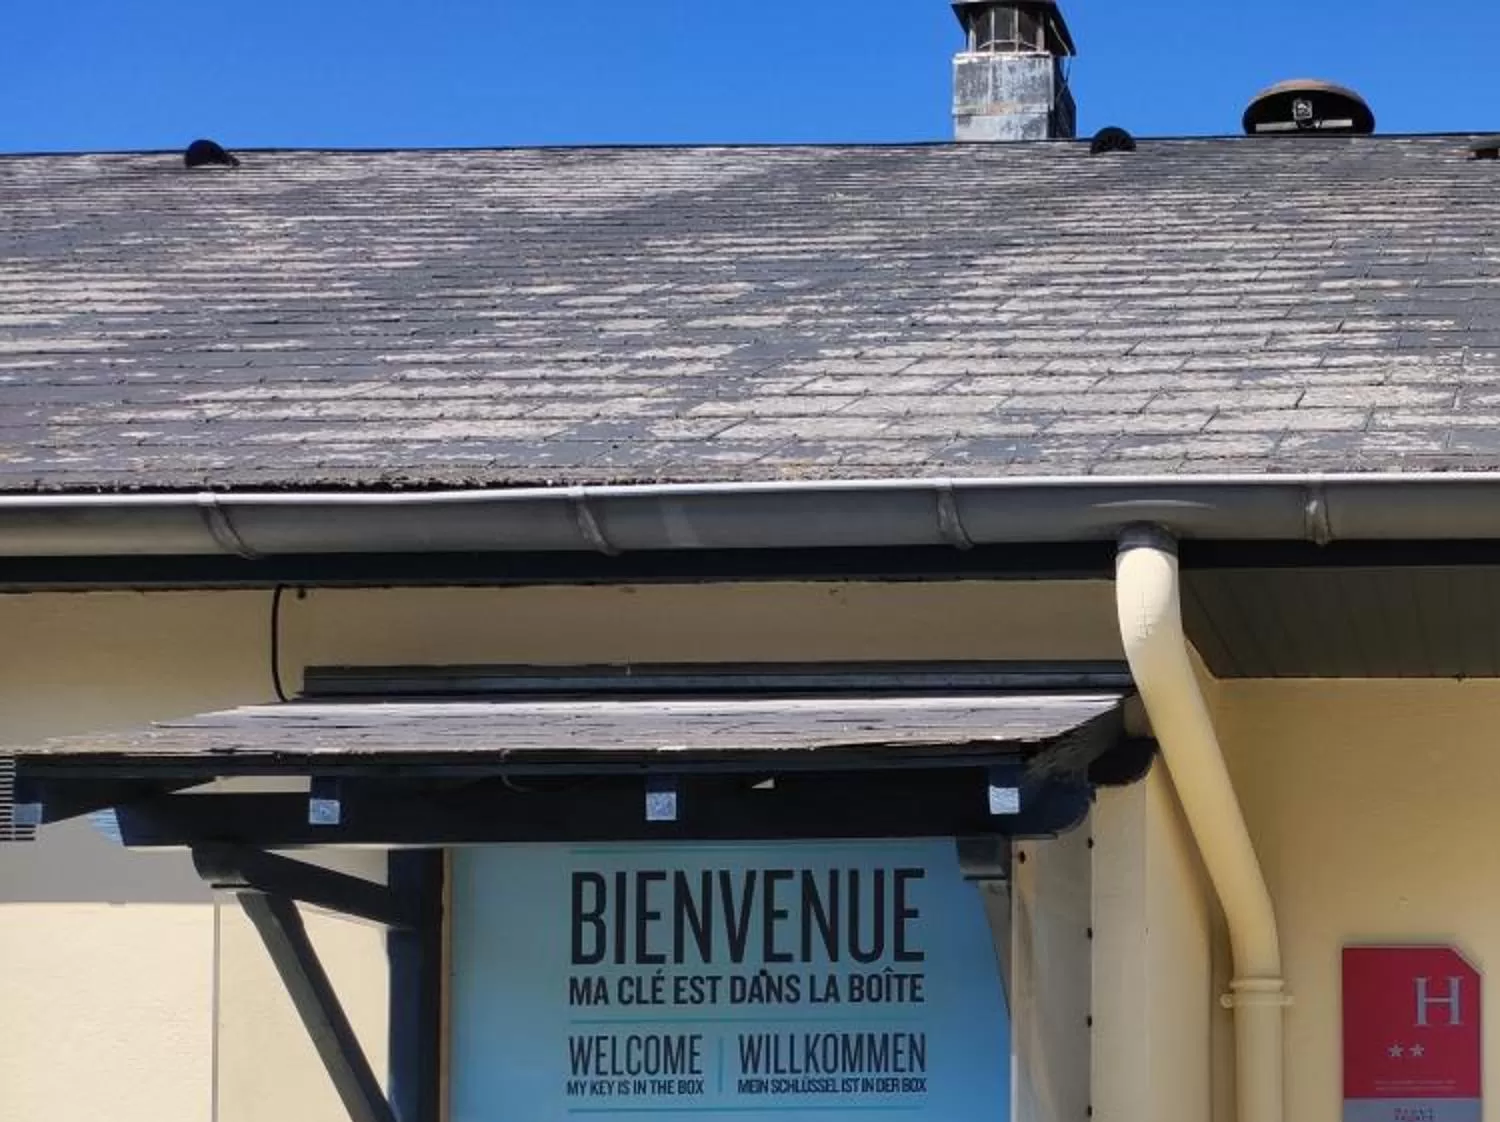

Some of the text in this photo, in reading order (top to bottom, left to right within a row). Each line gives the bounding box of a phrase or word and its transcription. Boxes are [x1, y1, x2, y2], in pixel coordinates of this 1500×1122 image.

[570, 867, 925, 965] BIENVENUE
[569, 966, 925, 1005] MA CLÉ EST DANS LA BOÎTE
[1413, 976, 1464, 1026] H
[569, 1034, 703, 1076] WELCOME
[738, 1032, 926, 1075] WILLKOMMEN
[567, 1079, 704, 1096] MY KEY IS IN THE BOX
[738, 1078, 769, 1093] MEIN
[841, 1077, 860, 1092] IST
[862, 1077, 875, 1092] IN
[876, 1077, 899, 1092] DER
[902, 1077, 927, 1092] BOX
